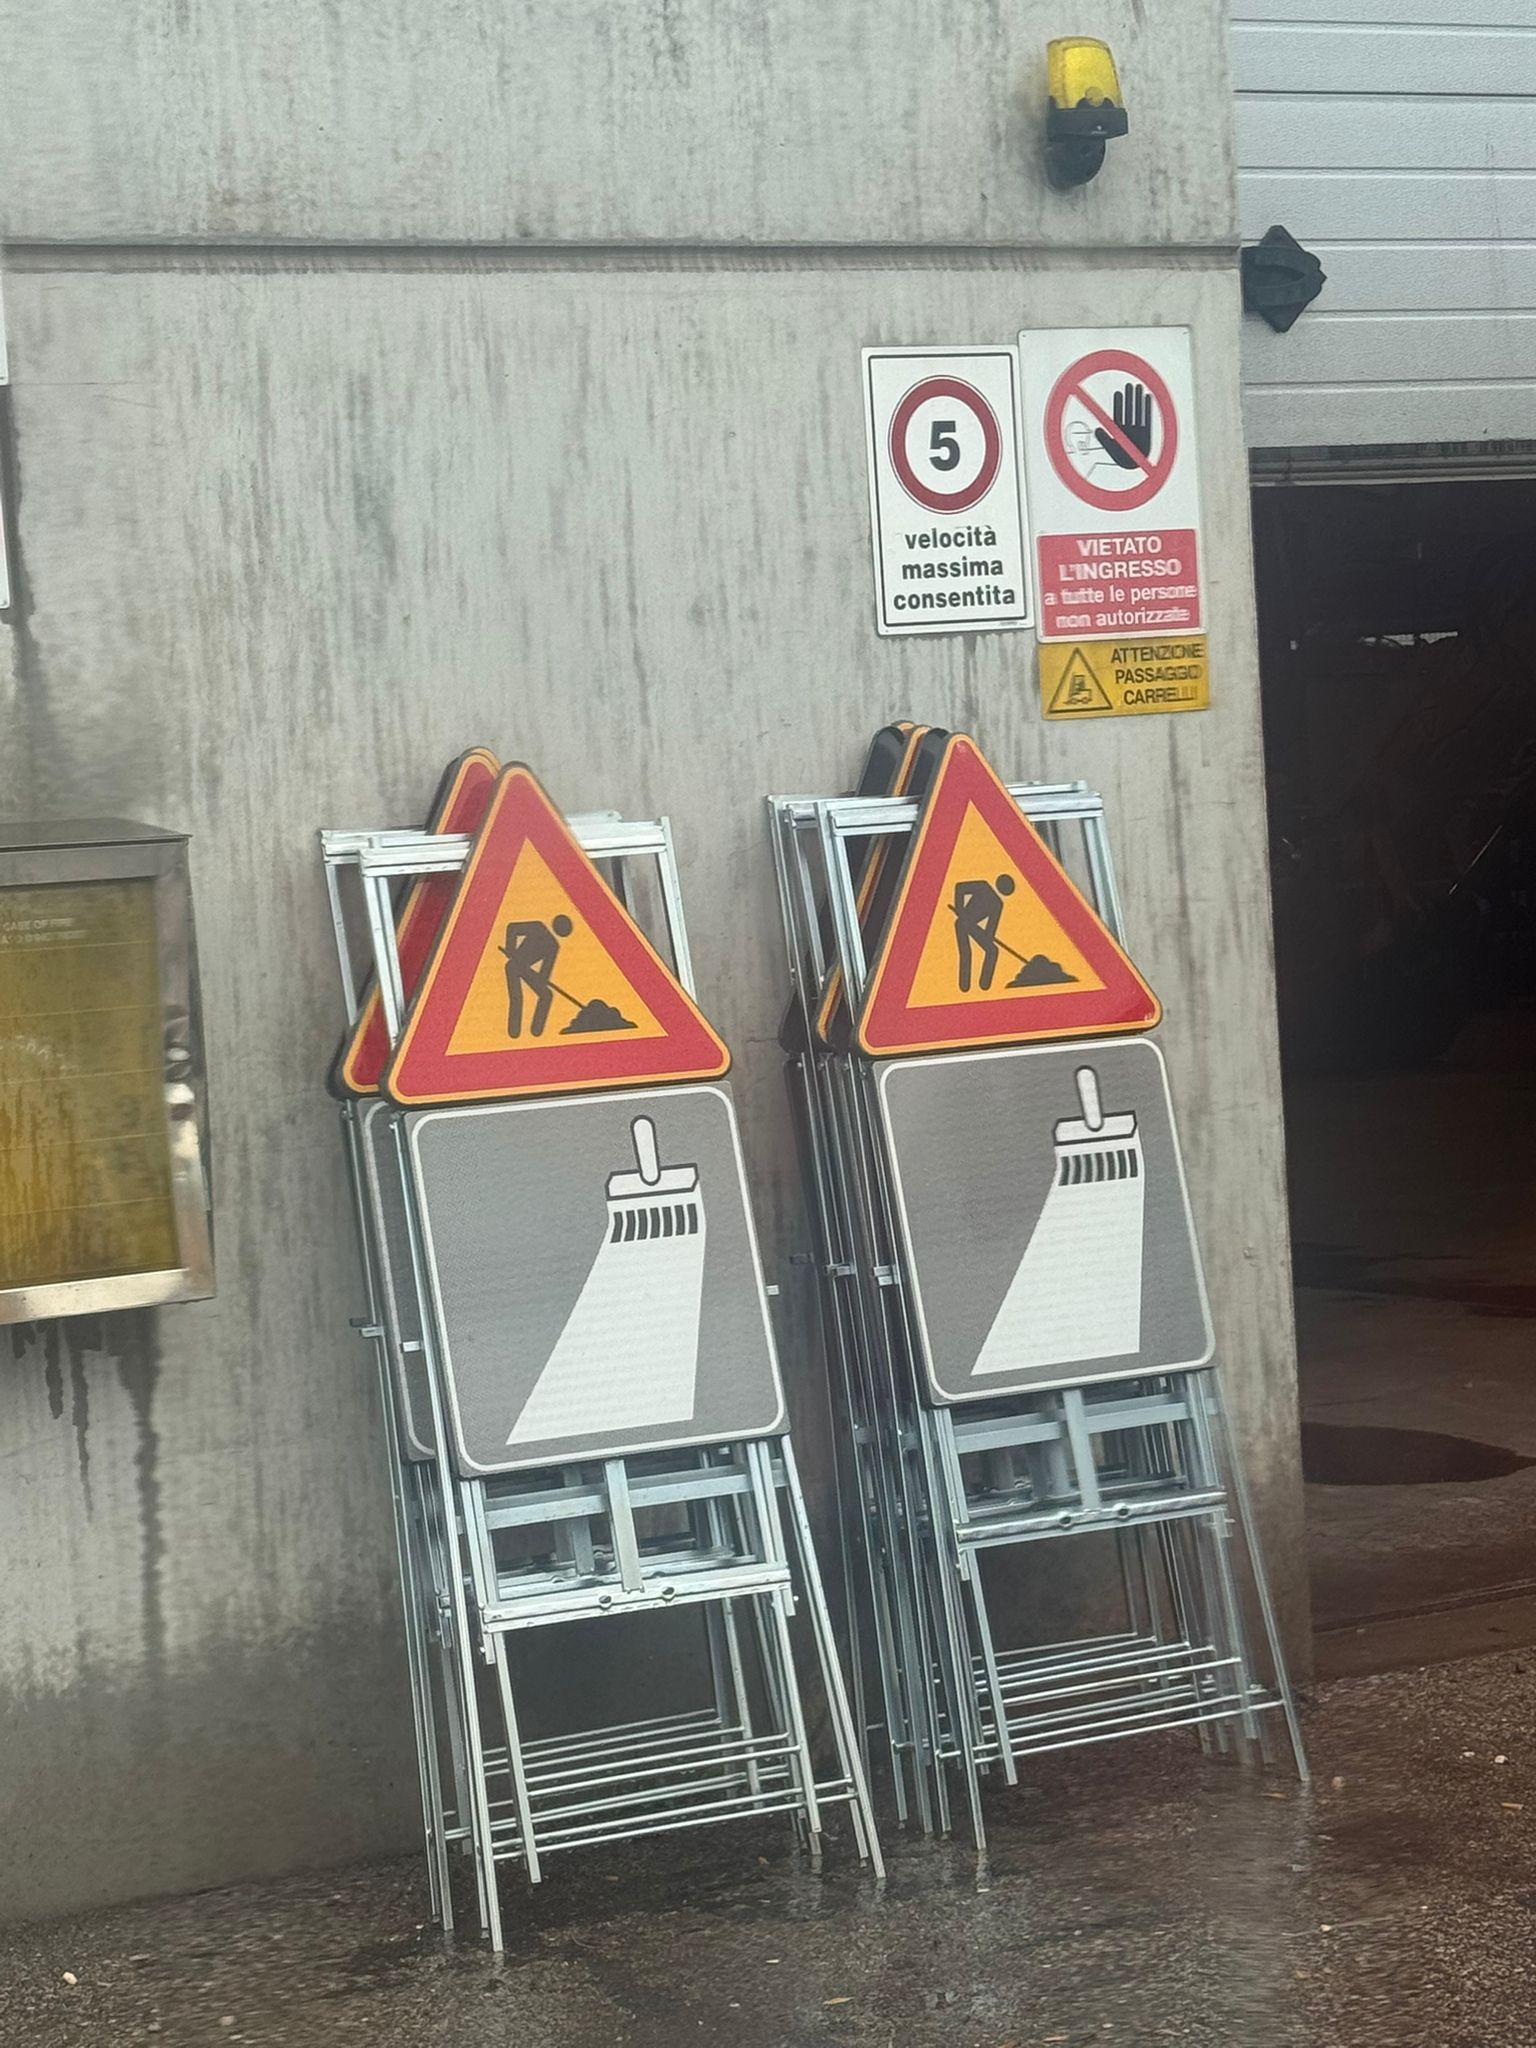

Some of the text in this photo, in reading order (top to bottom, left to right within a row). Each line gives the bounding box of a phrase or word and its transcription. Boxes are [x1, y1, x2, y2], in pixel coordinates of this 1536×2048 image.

[929, 420, 960, 471] 5
[904, 525, 997, 550] velocità
[1076, 536, 1162, 556] VIETATO
[902, 555, 1004, 580] massima
[1058, 558, 1182, 581] L'INGRESSO
[893, 584, 1016, 610] consentita
[1044, 592, 1058, 606] a
[1109, 585, 1125, 603] le
[1131, 584, 1197, 605] persone
[1096, 606, 1191, 627] autorizzate
